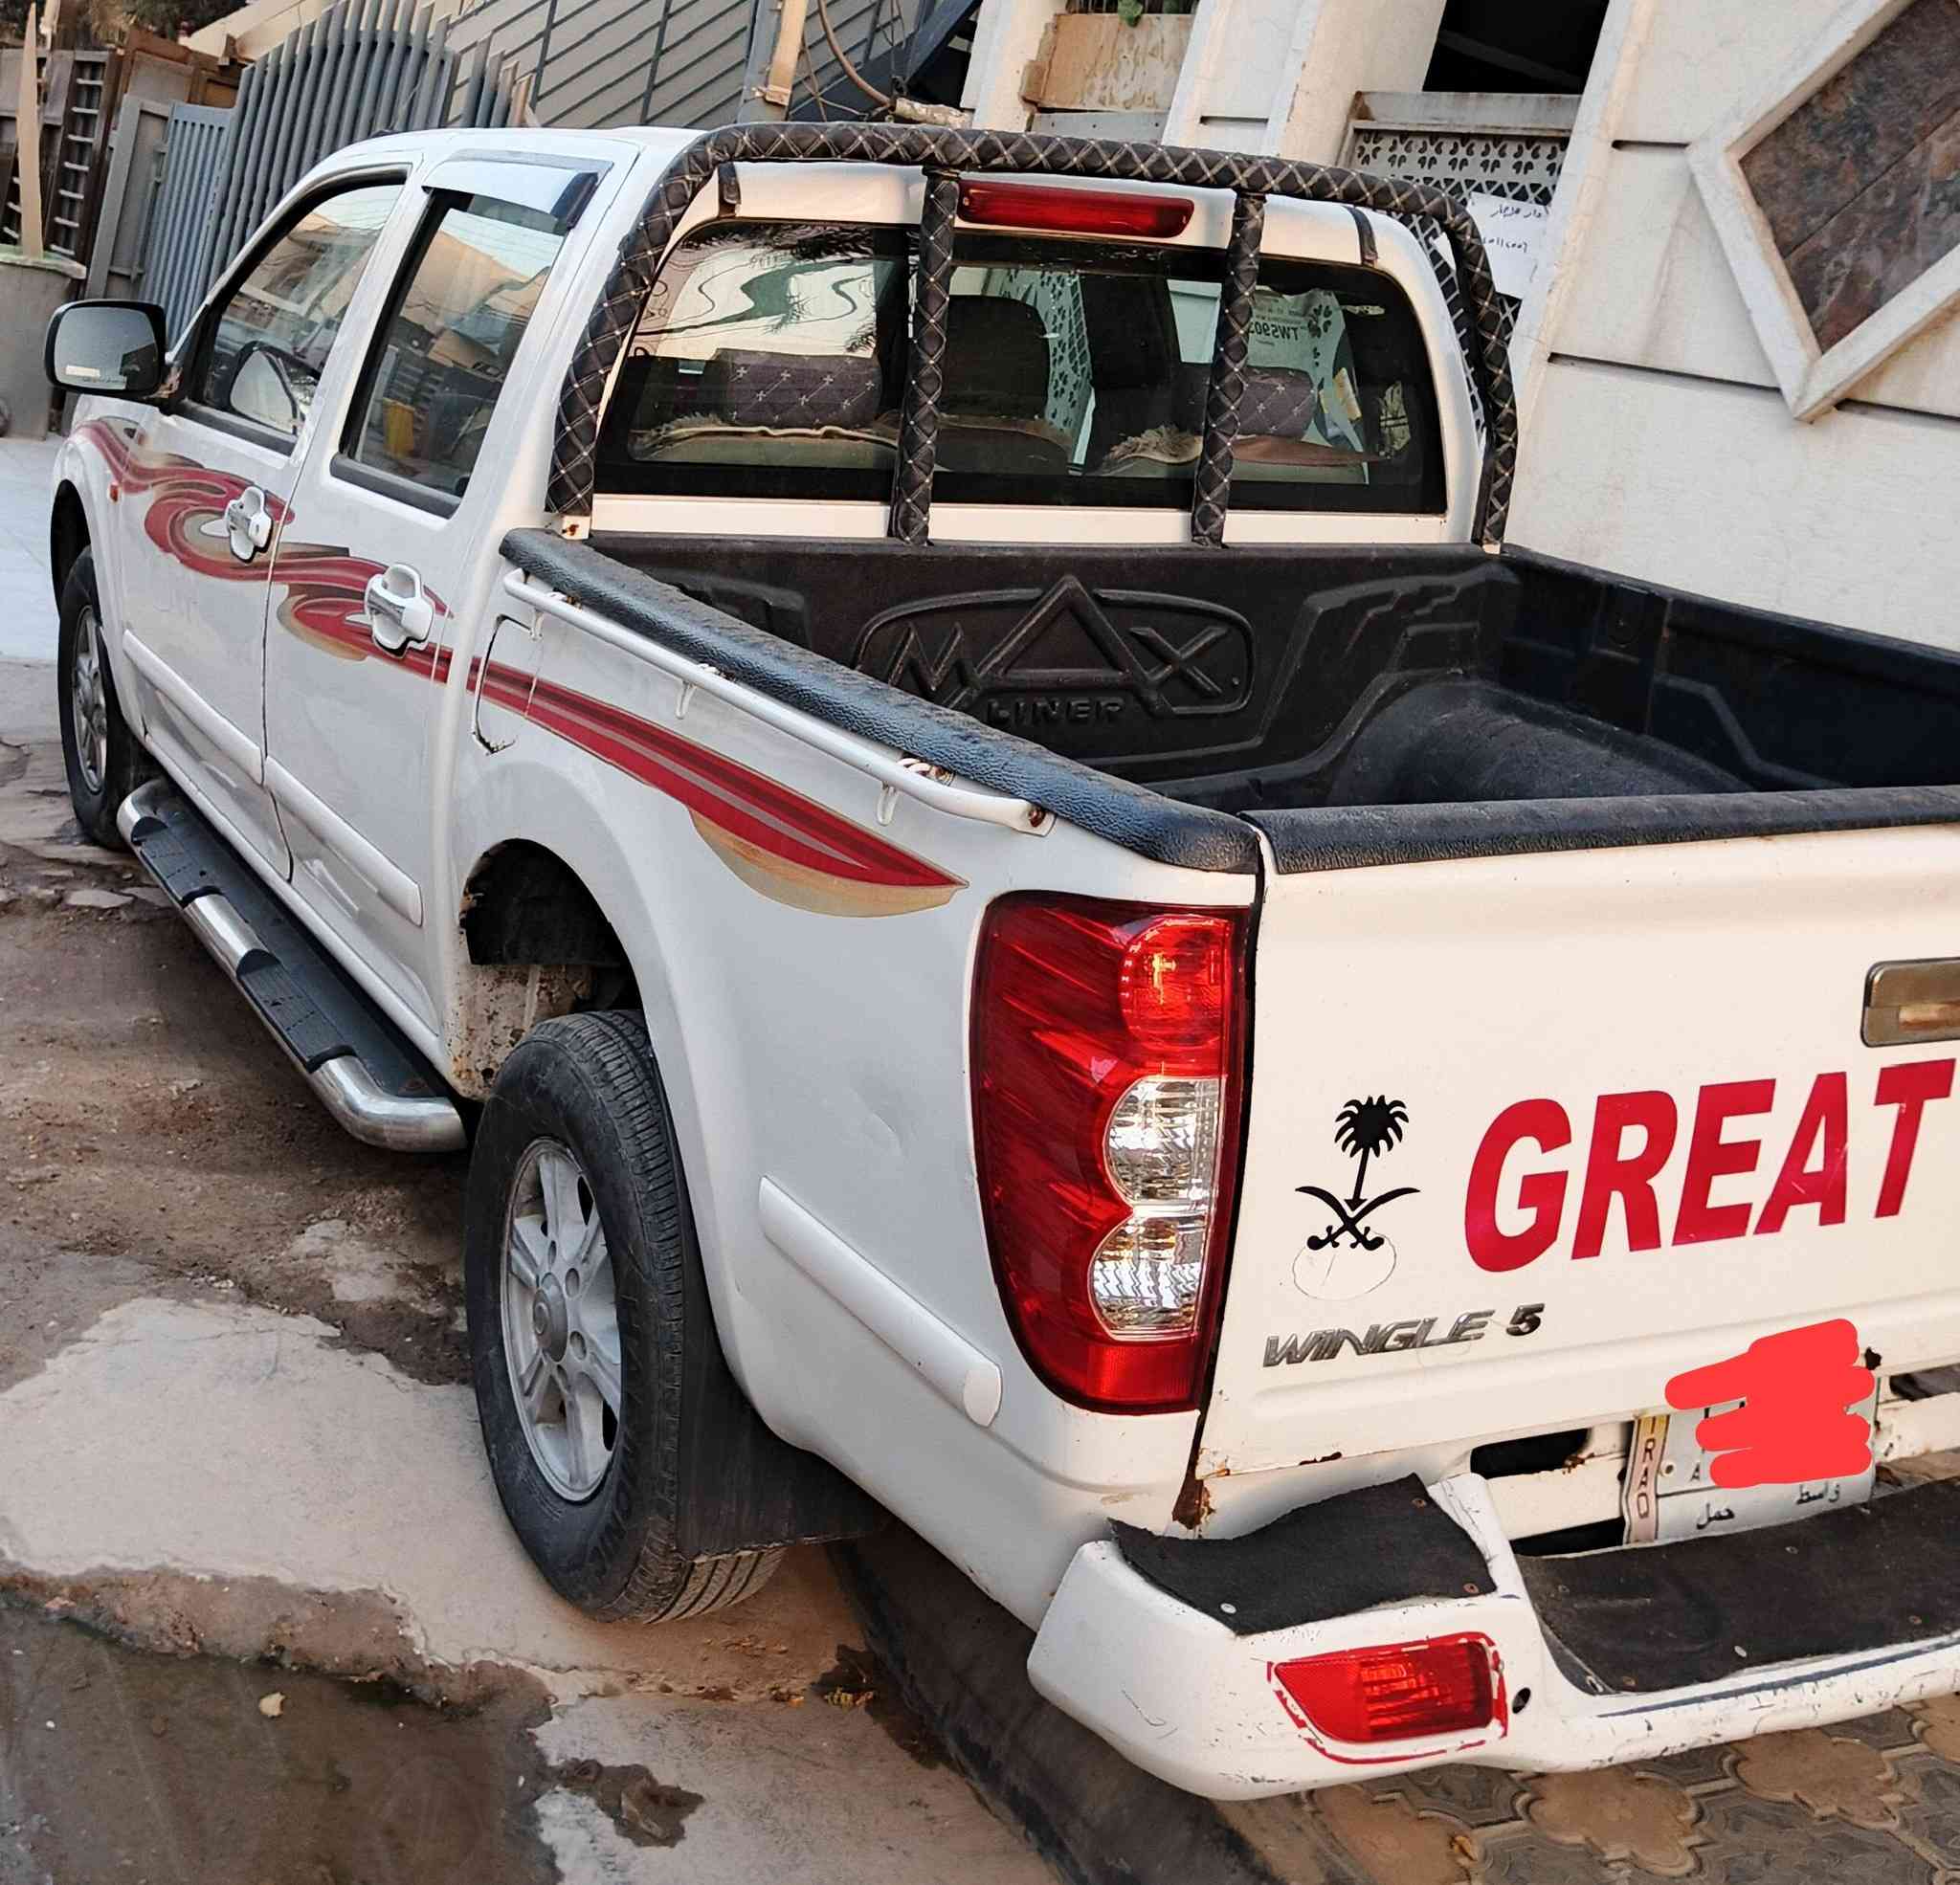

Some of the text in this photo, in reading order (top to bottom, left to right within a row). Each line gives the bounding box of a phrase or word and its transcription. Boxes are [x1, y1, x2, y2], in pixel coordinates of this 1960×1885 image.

[1465, 1058, 1956, 1273] GREAT
[1263, 1302, 1546, 1367] WINGLE 5
[1696, 1501, 1735, 1530] حمل
